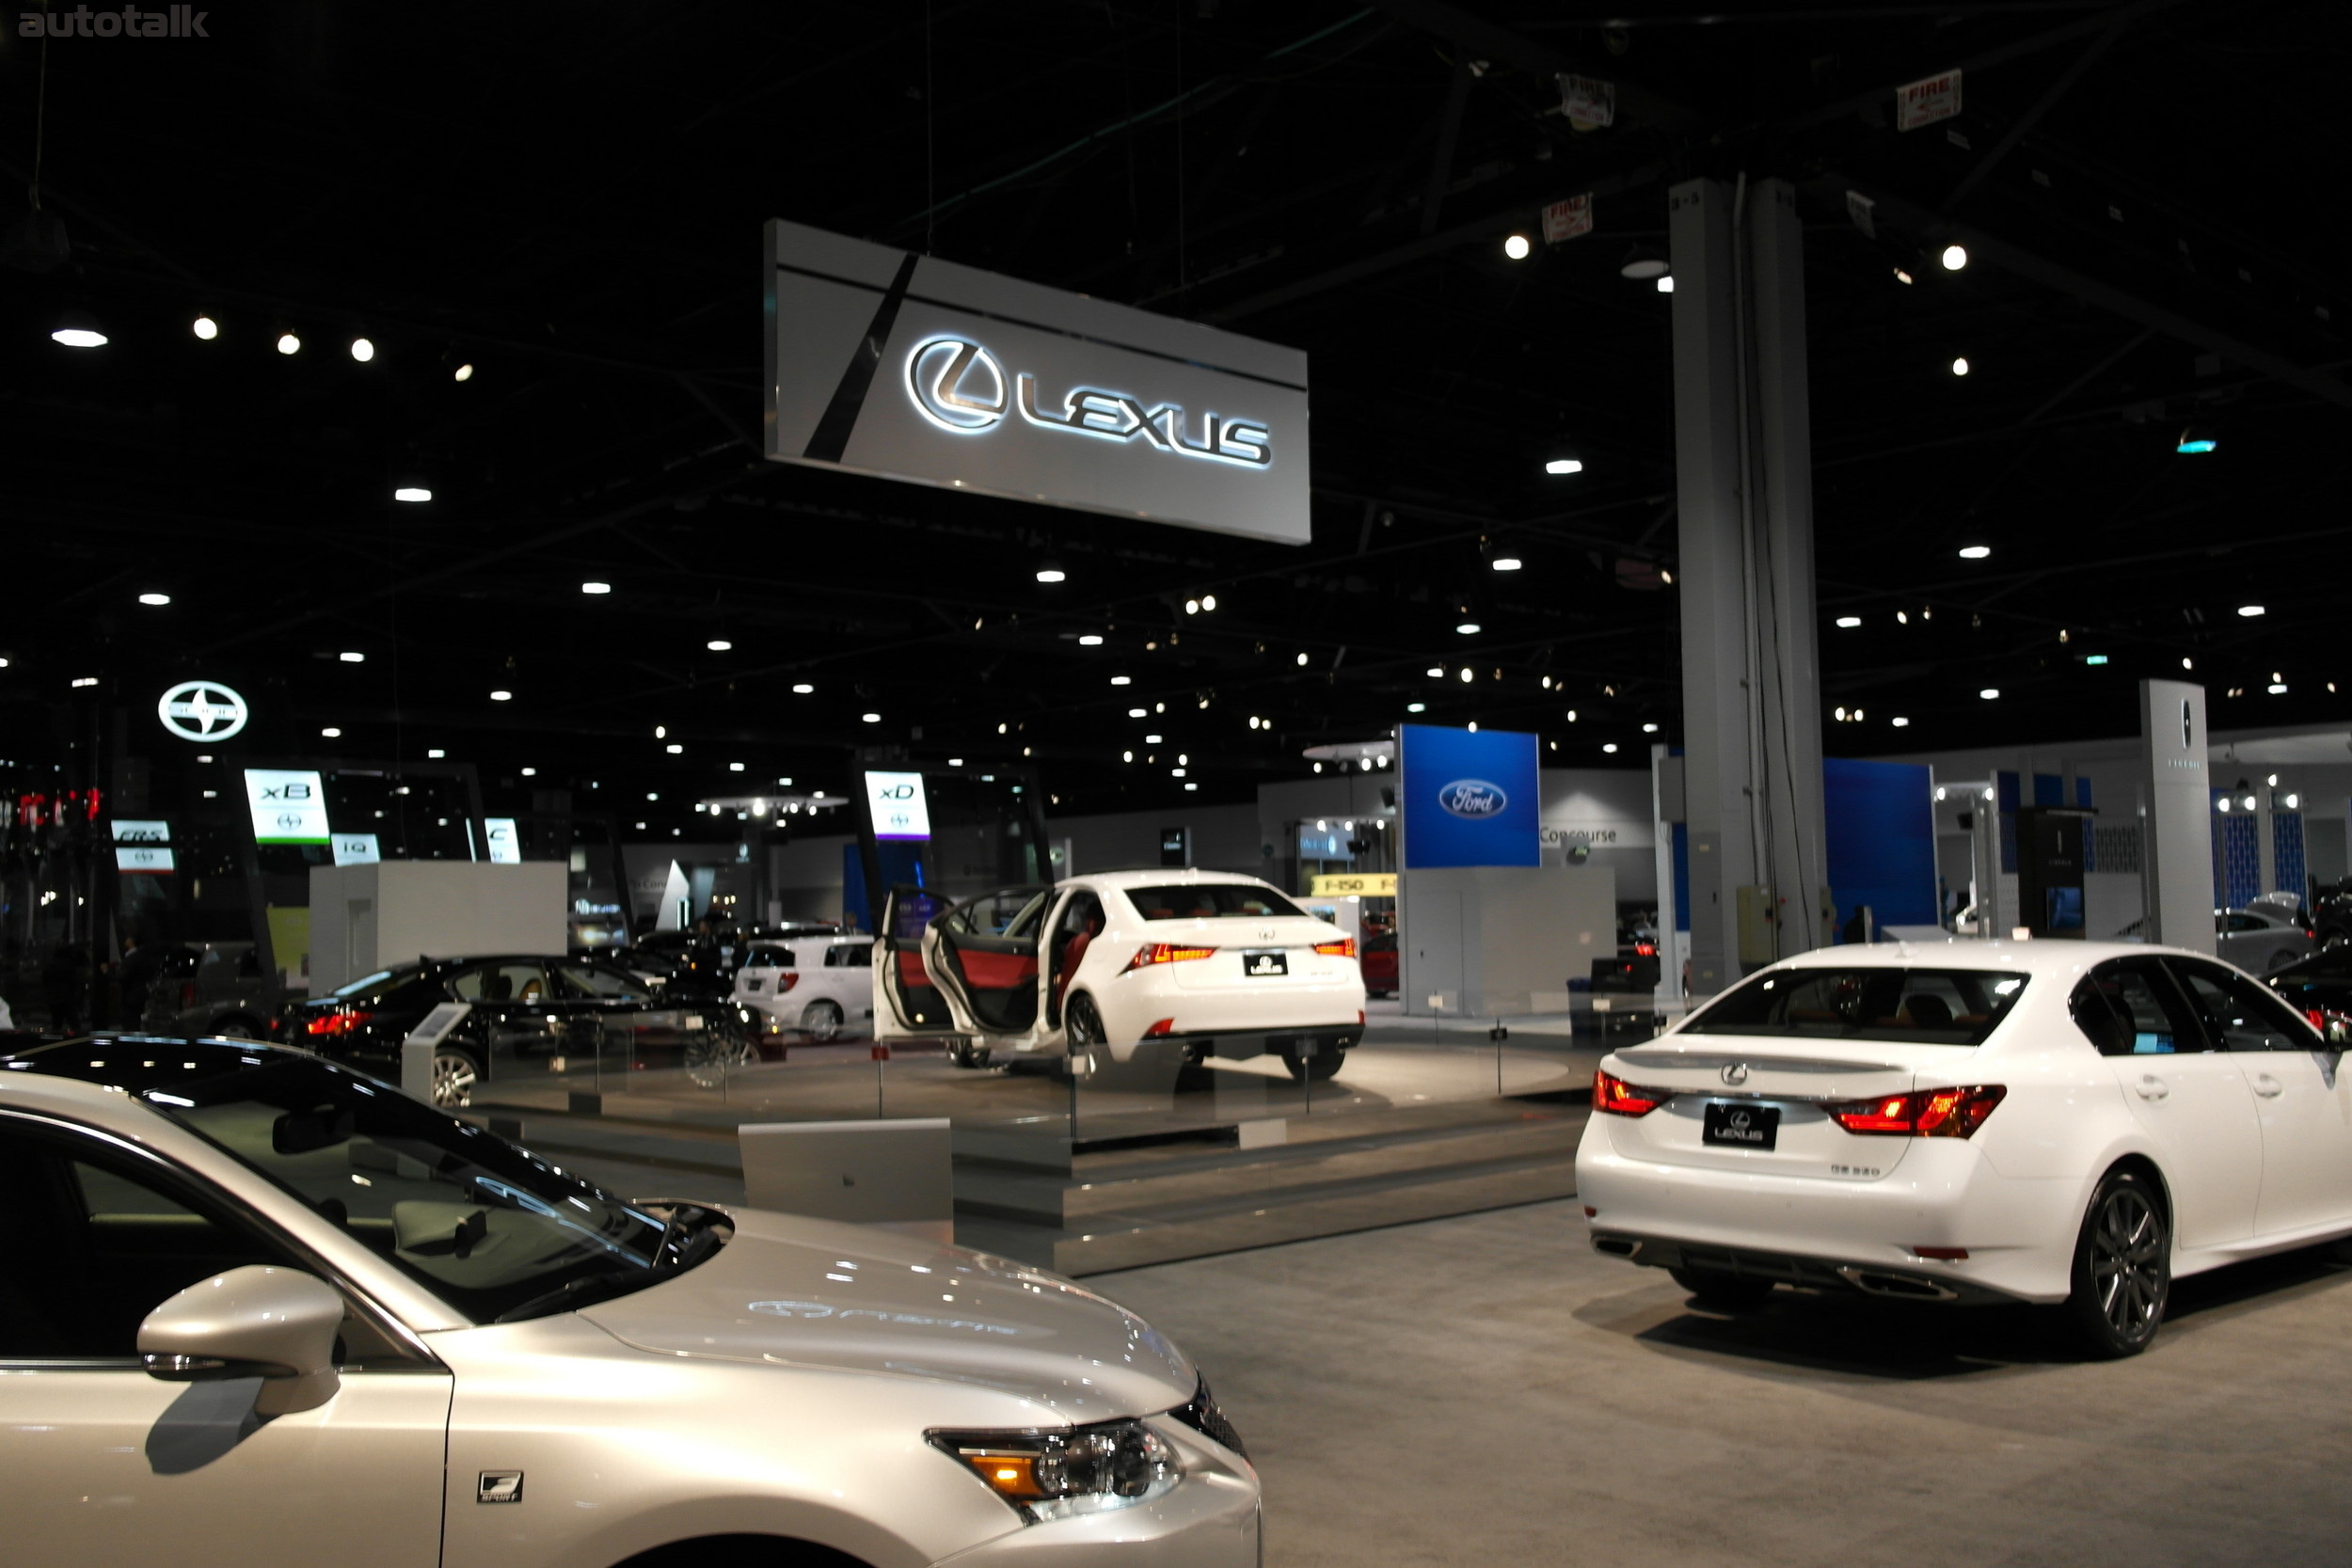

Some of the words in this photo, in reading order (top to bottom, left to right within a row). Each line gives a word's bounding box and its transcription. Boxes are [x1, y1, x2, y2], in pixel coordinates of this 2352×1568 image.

[1908, 78, 1950, 103] FIRE
[1550, 197, 1584, 219] FIRE
[1017, 372, 1271, 469] LEXUS
[261, 784, 310, 800] xB
[879, 784, 914, 800] xD
[1452, 784, 1494, 813] Ford
[1325, 879, 1364, 893] F-150
[1714, 1128, 1764, 1141] LEXUS
